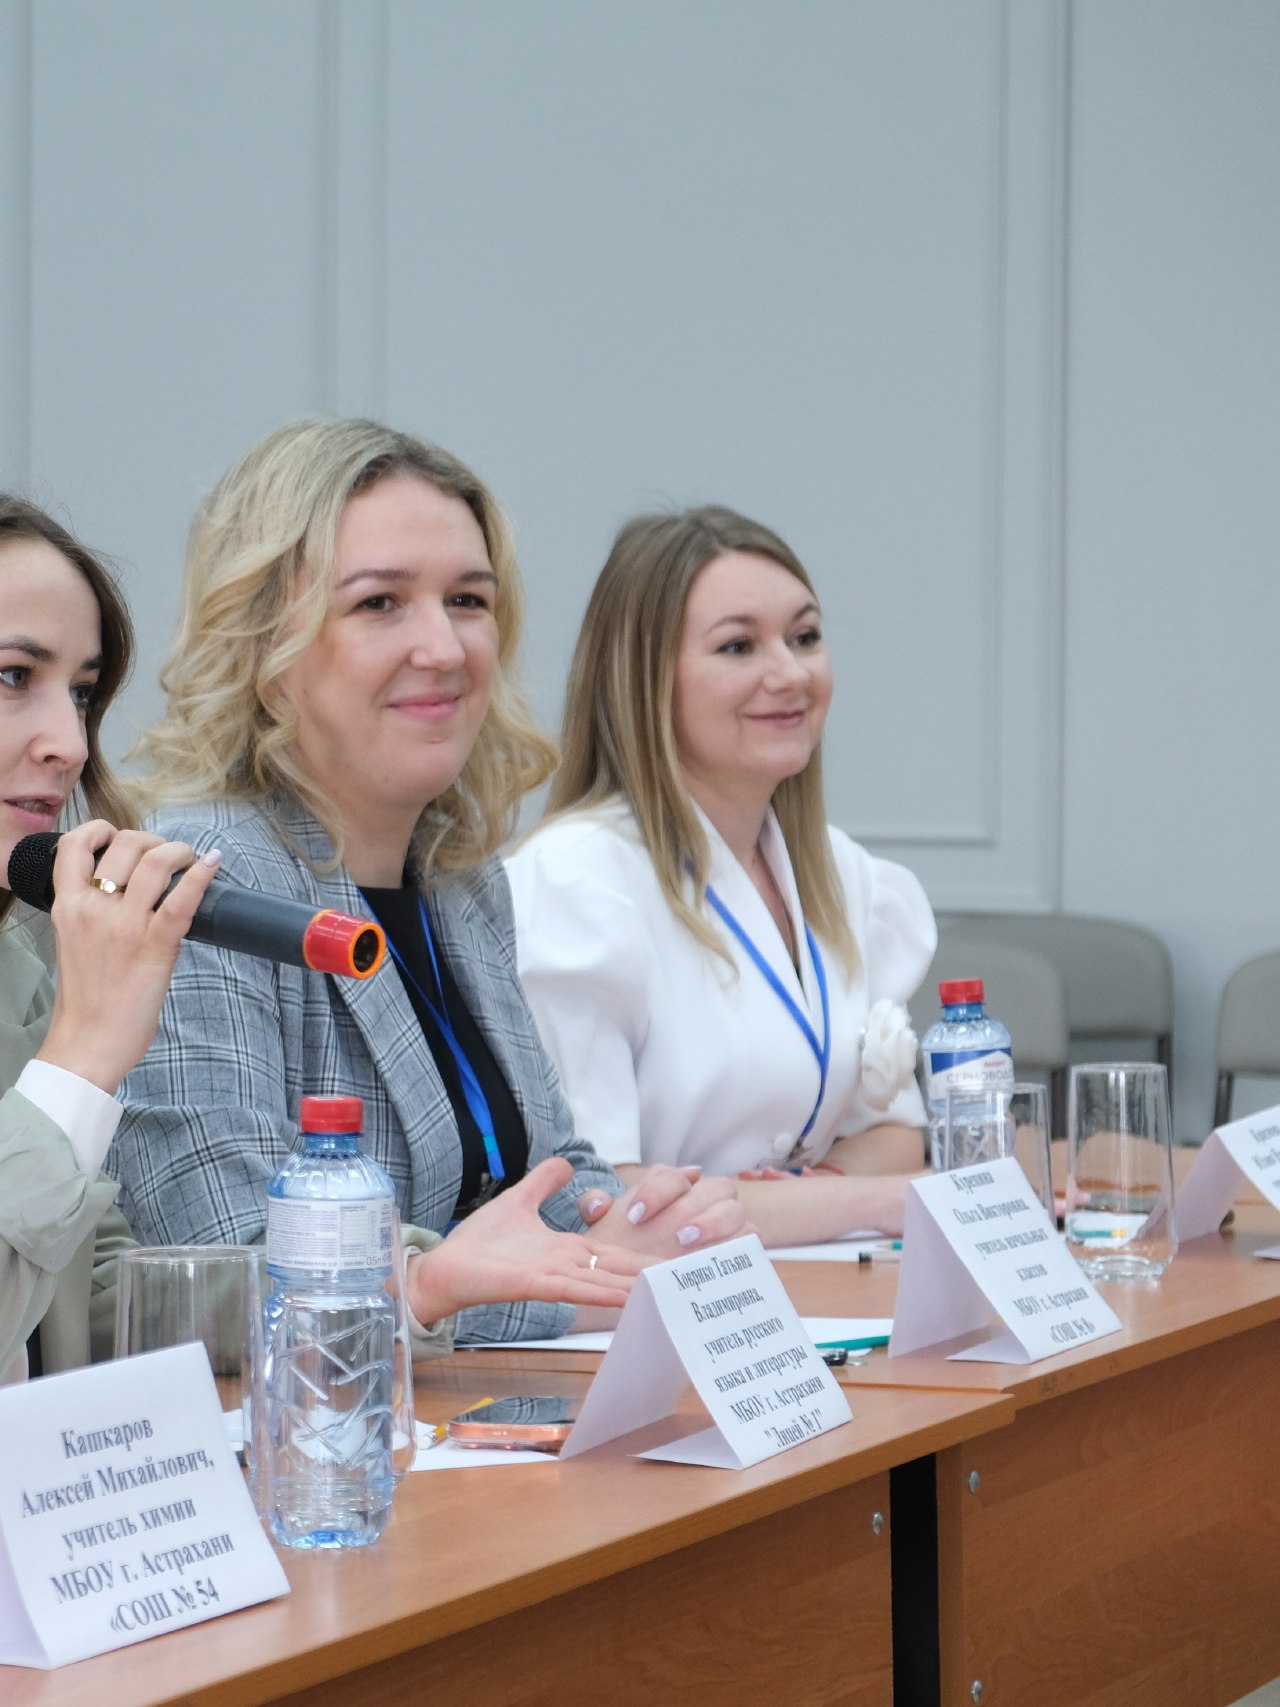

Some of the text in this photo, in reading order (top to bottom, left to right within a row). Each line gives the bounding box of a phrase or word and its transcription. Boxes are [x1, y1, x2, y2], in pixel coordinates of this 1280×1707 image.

[952, 1203, 981, 1225] Ольга
[974, 1228, 1049, 1260] учитель начальных
[711, 1253, 753, 1278] Татьяна
[1015, 1263, 1049, 1282] классов
[690, 1287, 764, 1323] Владимировна,
[1012, 1297, 1044, 1318] МБОУ
[1048, 1287, 1090, 1311] Астрахани
[703, 1316, 785, 1364] учитель русского
[714, 1345, 808, 1394] языка и литературы
[729, 1375, 826, 1426] МБОУ г. Астрахани
[61, 1418, 153, 1459] Кашкаров
[763, 1408, 823, 1449] "Лицей № 1"
[20, 1450, 215, 1519] Алексей Михайлович,
[61, 1497, 197, 1561] учитель химии
[49, 1532, 236, 1605] МБОУ г. Астрахани
[109, 1576, 220, 1634] «СОШ № 54
